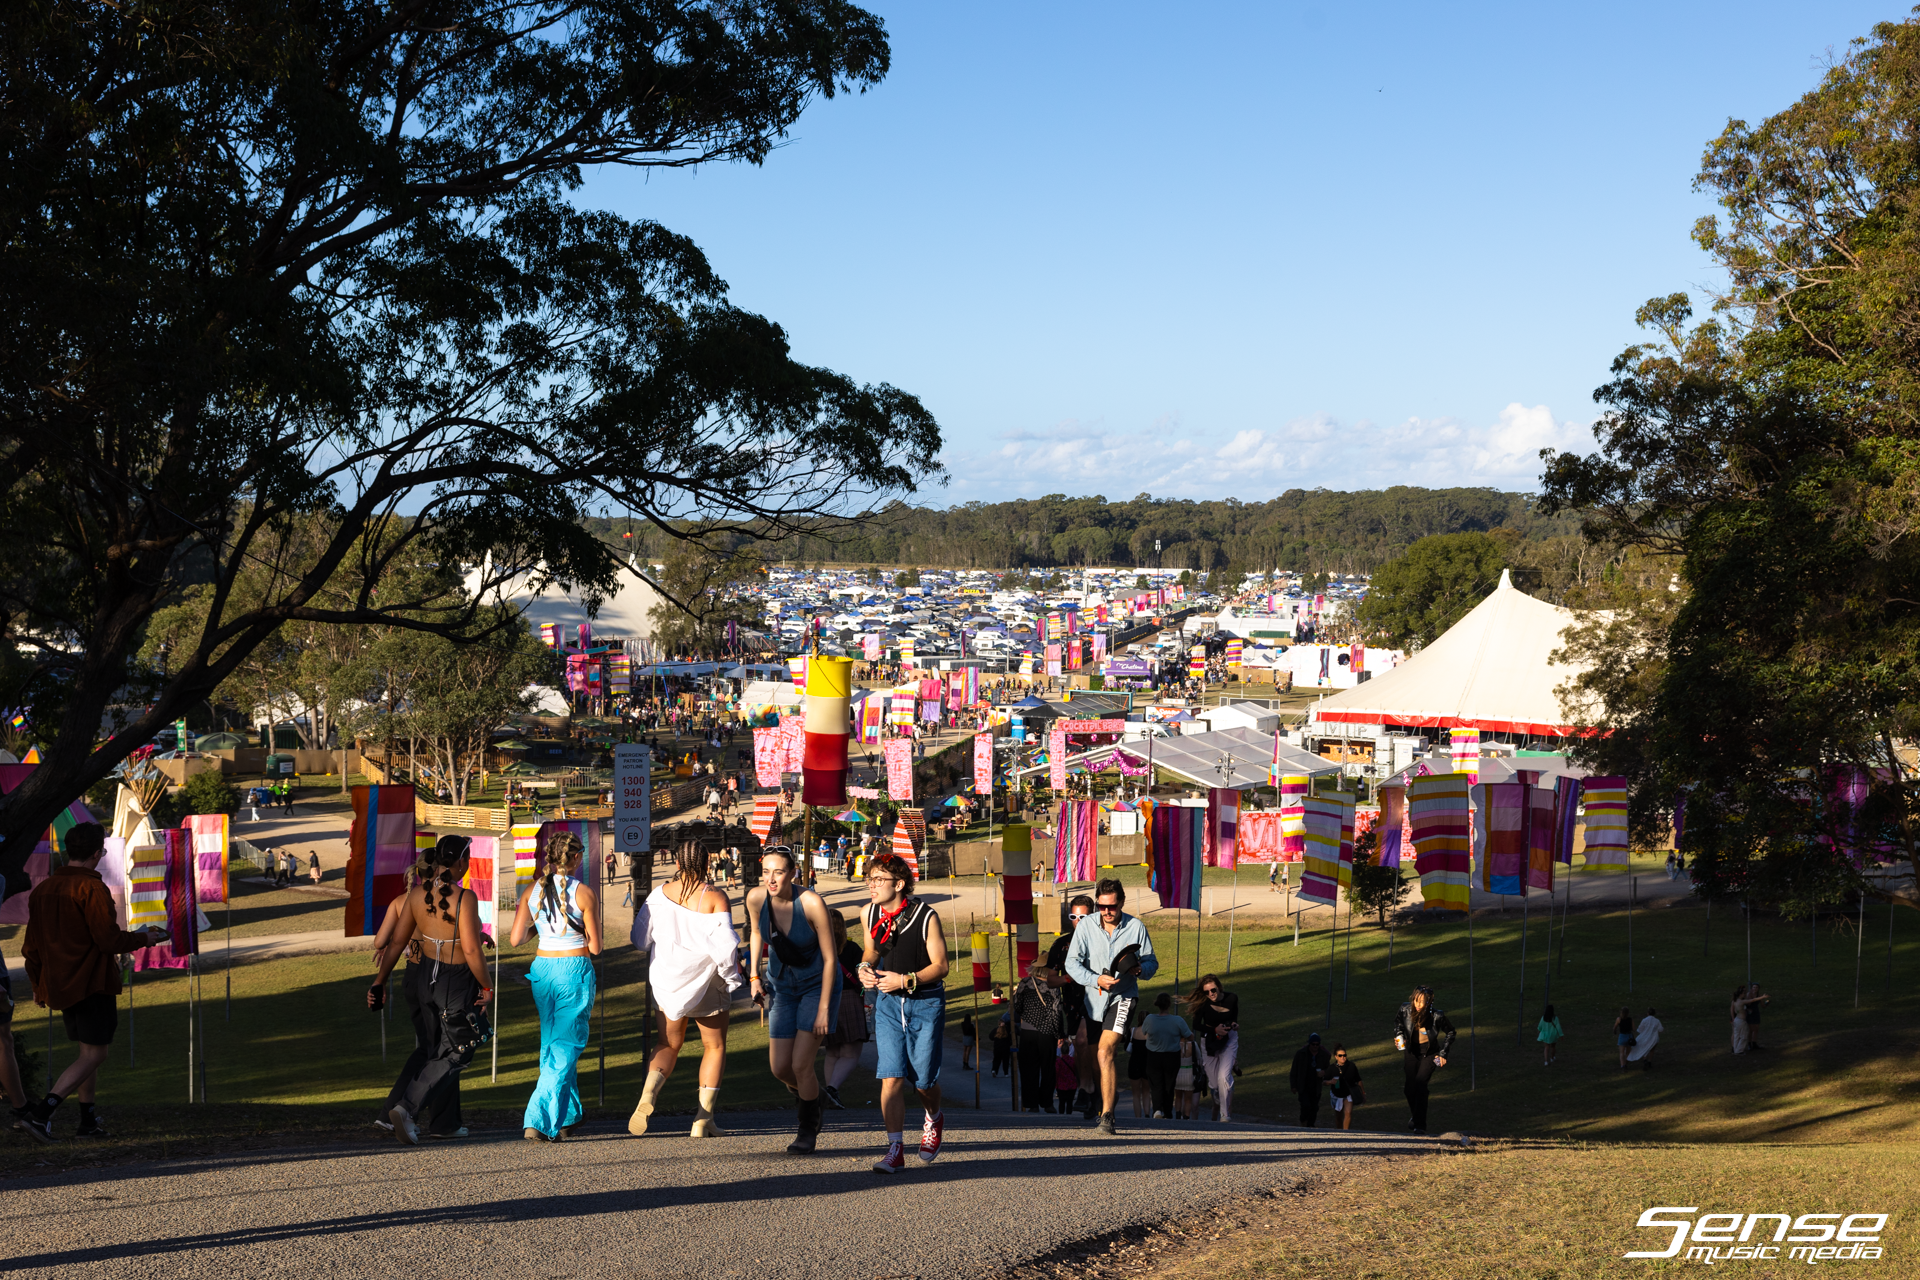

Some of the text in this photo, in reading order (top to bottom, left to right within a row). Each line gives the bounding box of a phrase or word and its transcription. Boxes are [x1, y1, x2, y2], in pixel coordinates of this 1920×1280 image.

[1328, 722, 1368, 736] VIP
[622, 776, 645, 785] 1300
[624, 788, 642, 797] 940
[624, 800, 642, 809] 928
